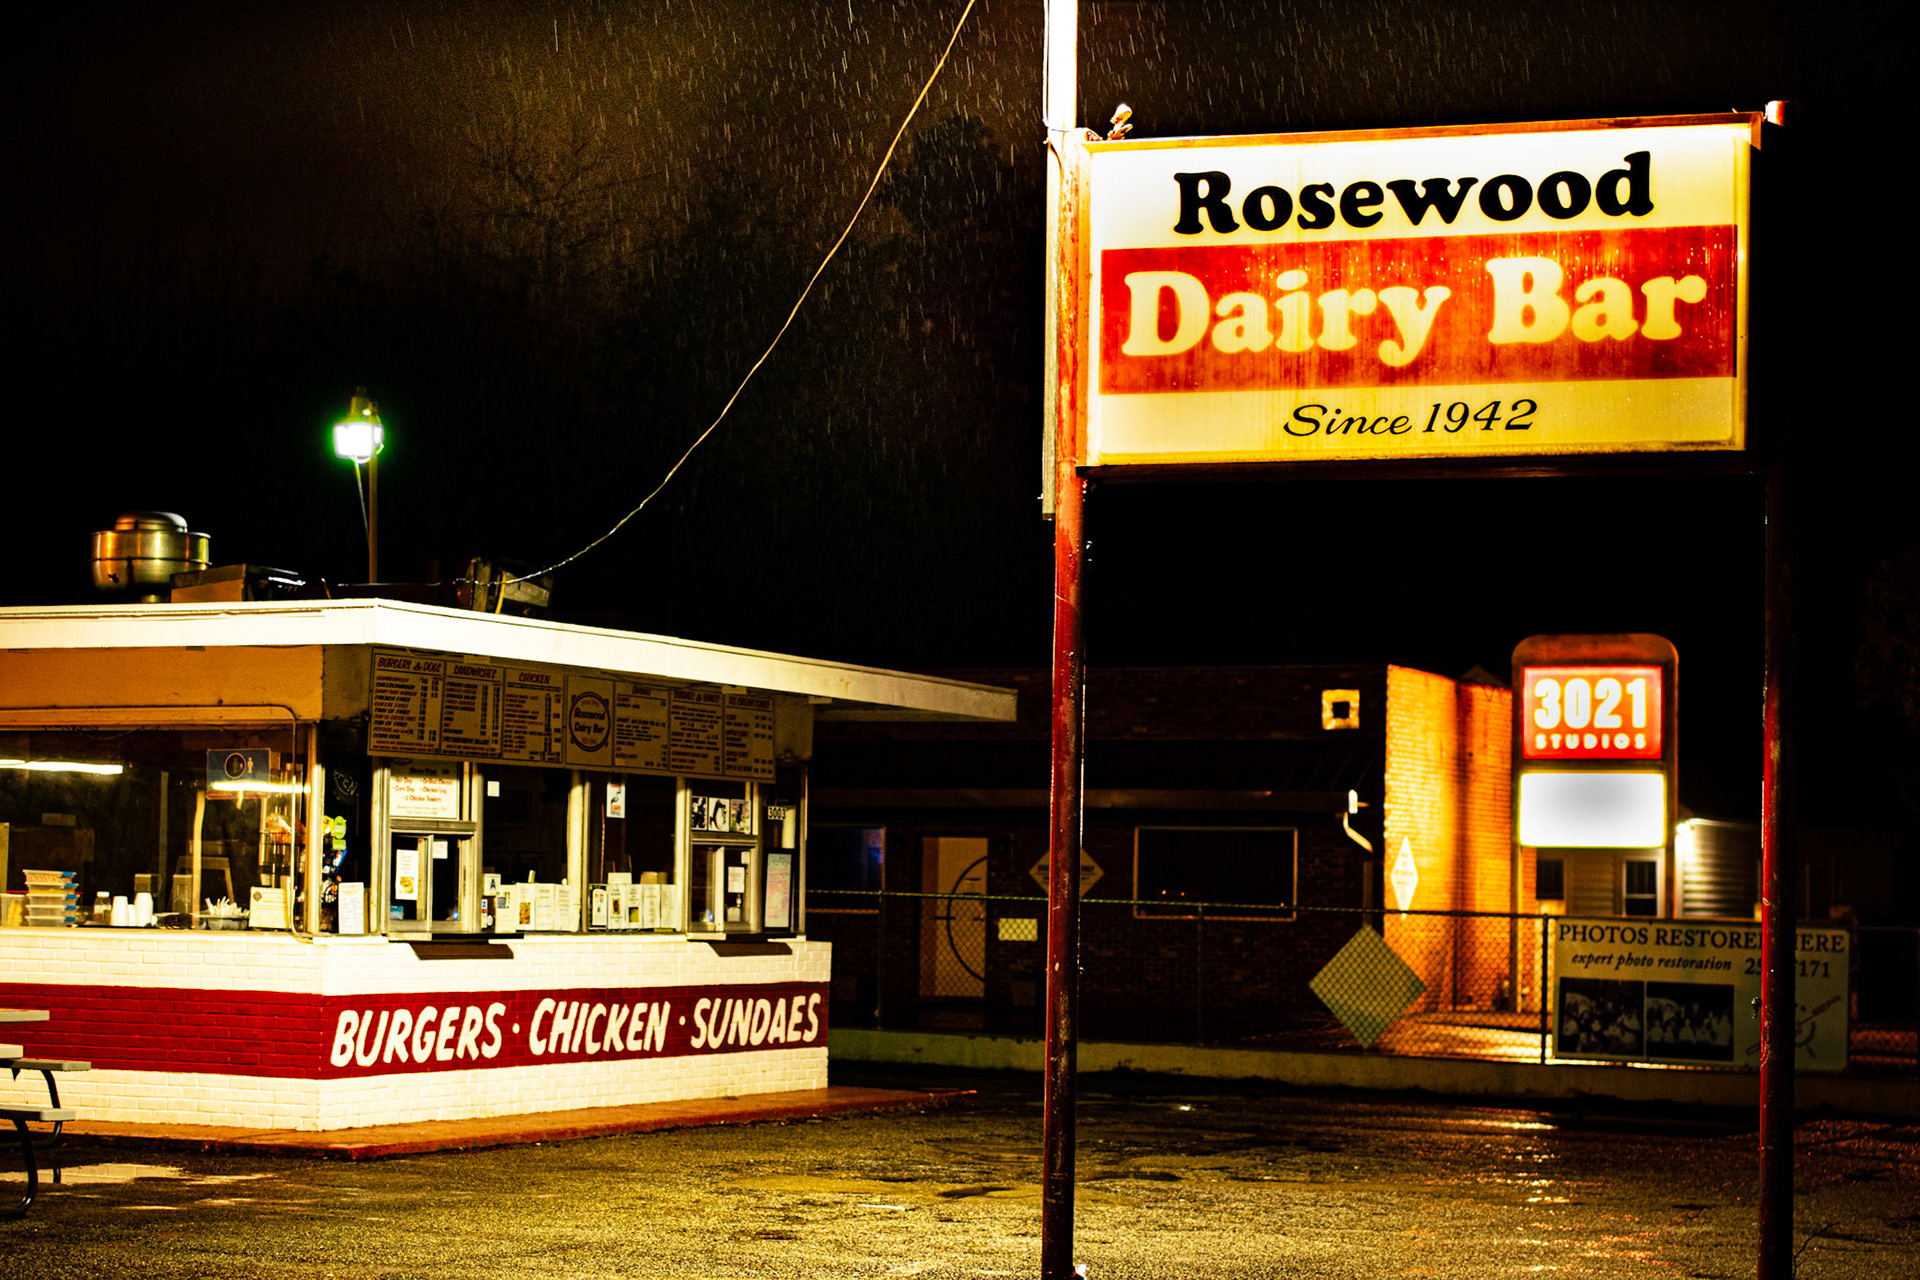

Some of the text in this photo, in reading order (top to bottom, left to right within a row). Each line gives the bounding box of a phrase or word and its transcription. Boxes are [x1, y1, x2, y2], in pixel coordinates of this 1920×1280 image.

[1173, 151, 1655, 234] Rosewood
[1121, 256, 1708, 367] Dairy Bar
[1283, 398, 1537, 436] Since 1942
[574, 707, 606, 720] Rosewood
[1534, 678, 1646, 729] 3021
[574, 722, 605, 735] Dairy Bar
[1535, 733, 1646, 749] STUDIOS
[490, 879, 496, 889] A
[1559, 924, 1845, 953] PHOTOS RESTORE ERE
[1572, 953, 1732, 970] expert photo restoration
[329, 992, 821, 1068] BURGERS CHICKEN SUNDAES
